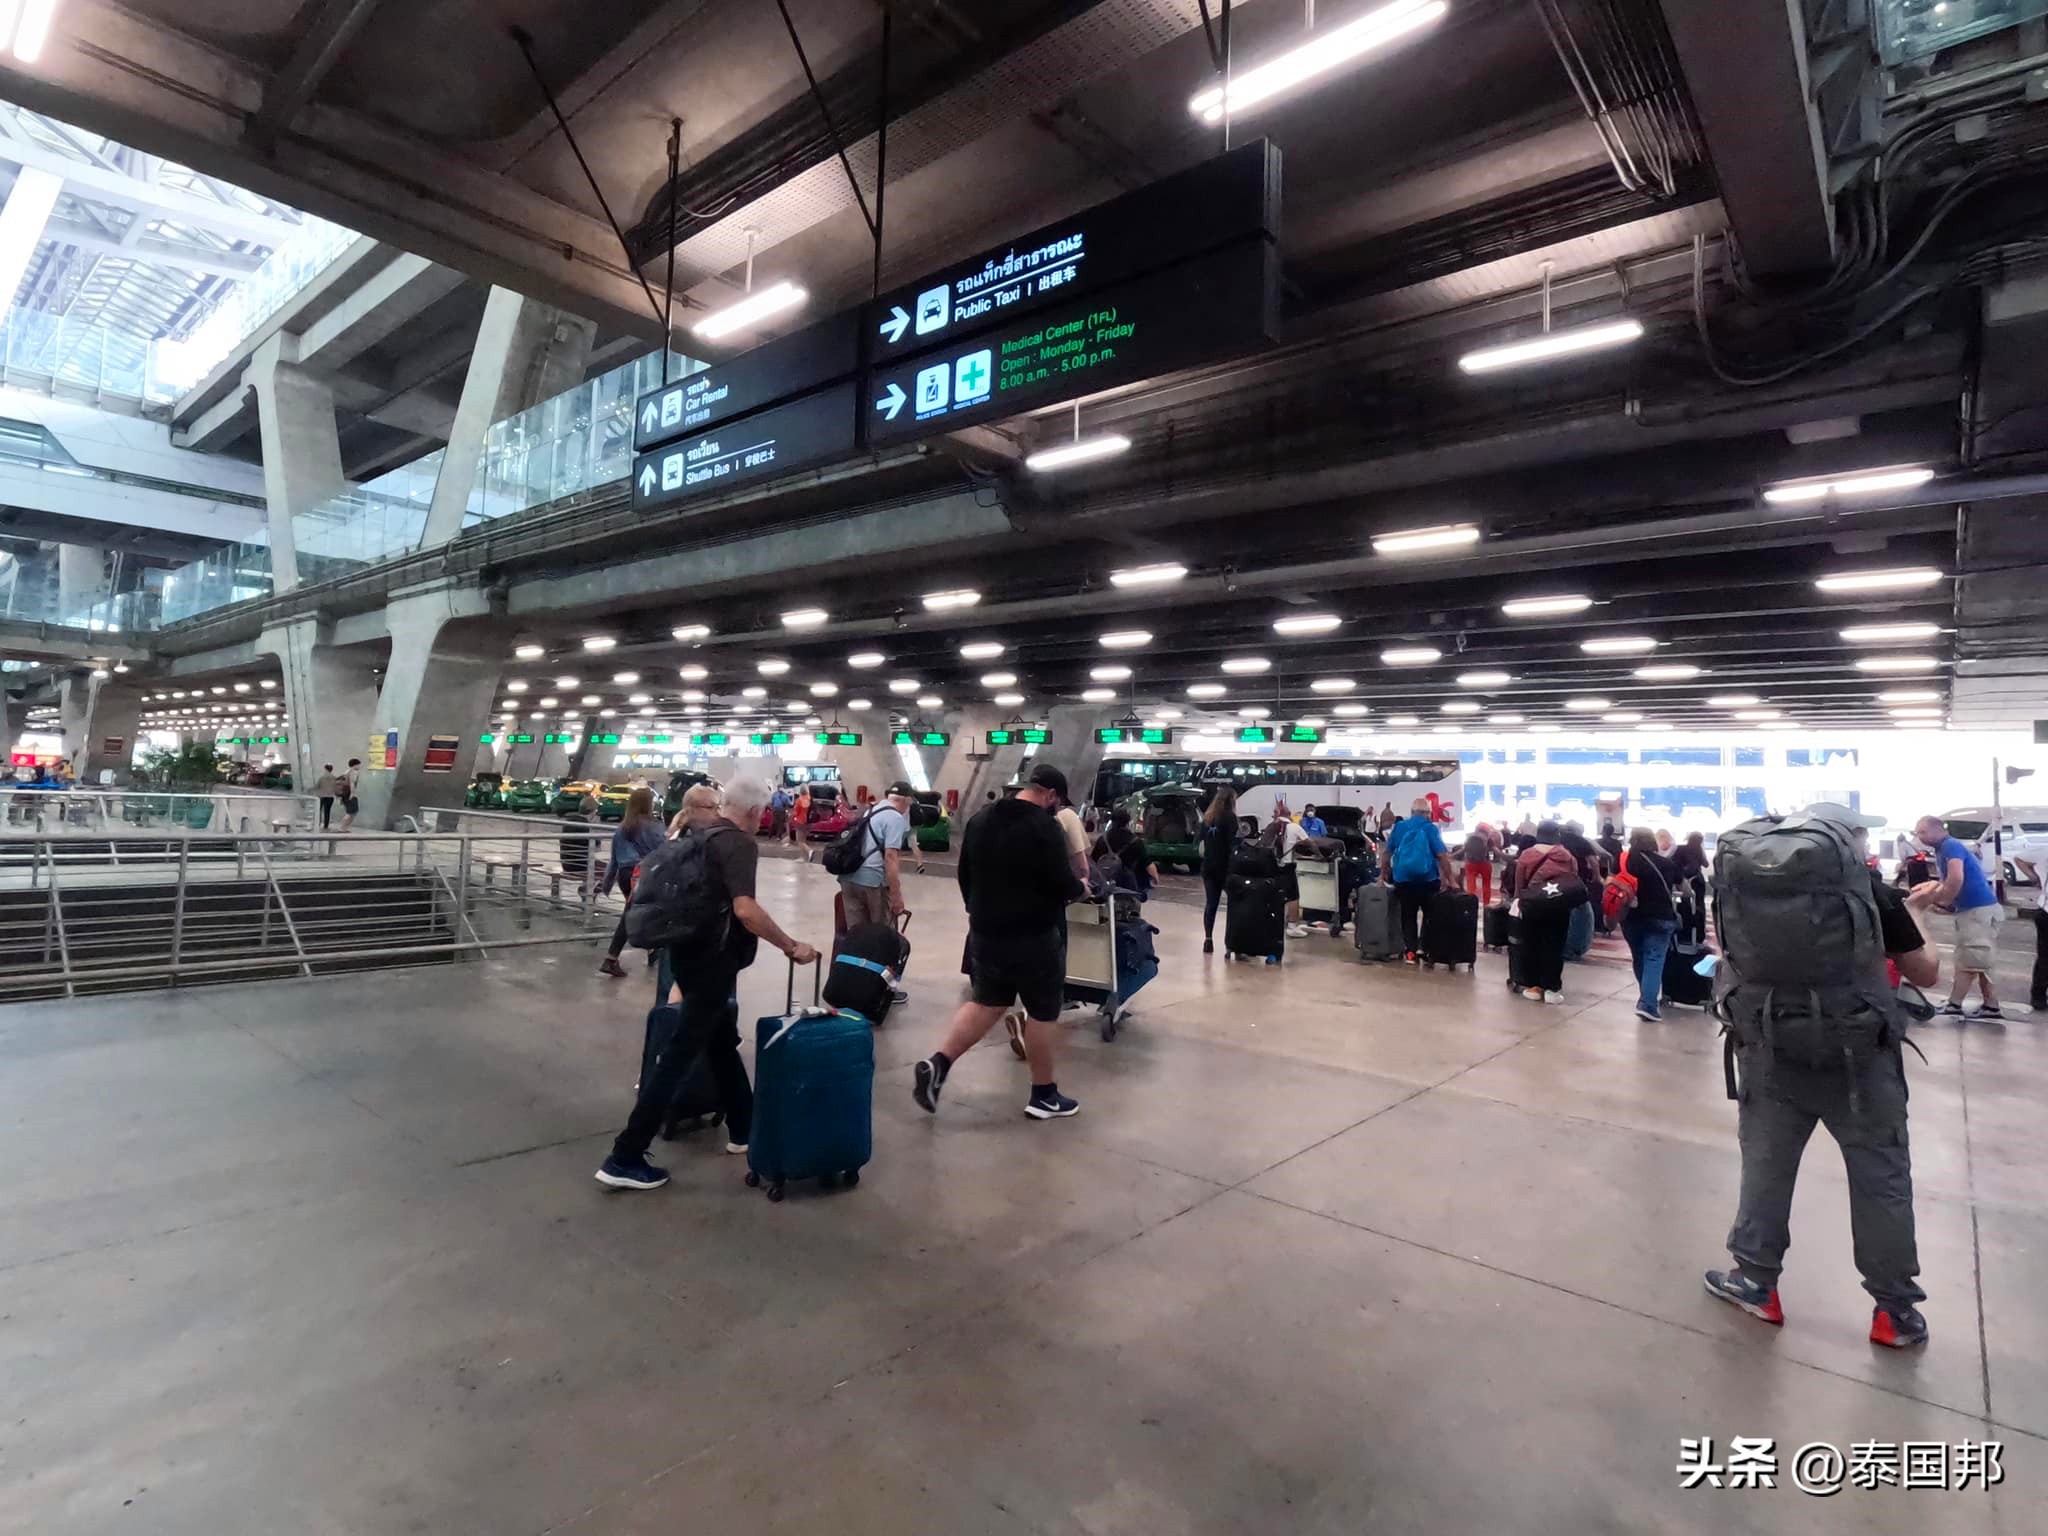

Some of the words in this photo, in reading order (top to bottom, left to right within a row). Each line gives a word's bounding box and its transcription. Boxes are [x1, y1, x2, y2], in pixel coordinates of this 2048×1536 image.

[957, 233, 1082, 293] รถแท็กซี่สาธารณะ
[1038, 265, 1077, 291] 出租车
[954, 298, 992, 322] Public
[994, 285, 1020, 307] Taxi
[1000, 355, 1031, 372] Open
[1040, 337, 1086, 360] Monday
[1096, 322, 1136, 343] Friday
[1001, 330, 1043, 355] Medical
[1045, 319, 1085, 340] Center
[1087, 307, 1117, 330] (1FL)
[1000, 372, 1024, 390] 8.00
[1026, 367, 1050, 382] a.m.
[1060, 353, 1087, 372] 5.00
[1089, 348, 1116, 367] p.m.
[685, 397, 700, 411] Car
[701, 384, 729, 404] Rental
[685, 467, 713, 485] Shuttle
[714, 463, 730, 478] Bus
